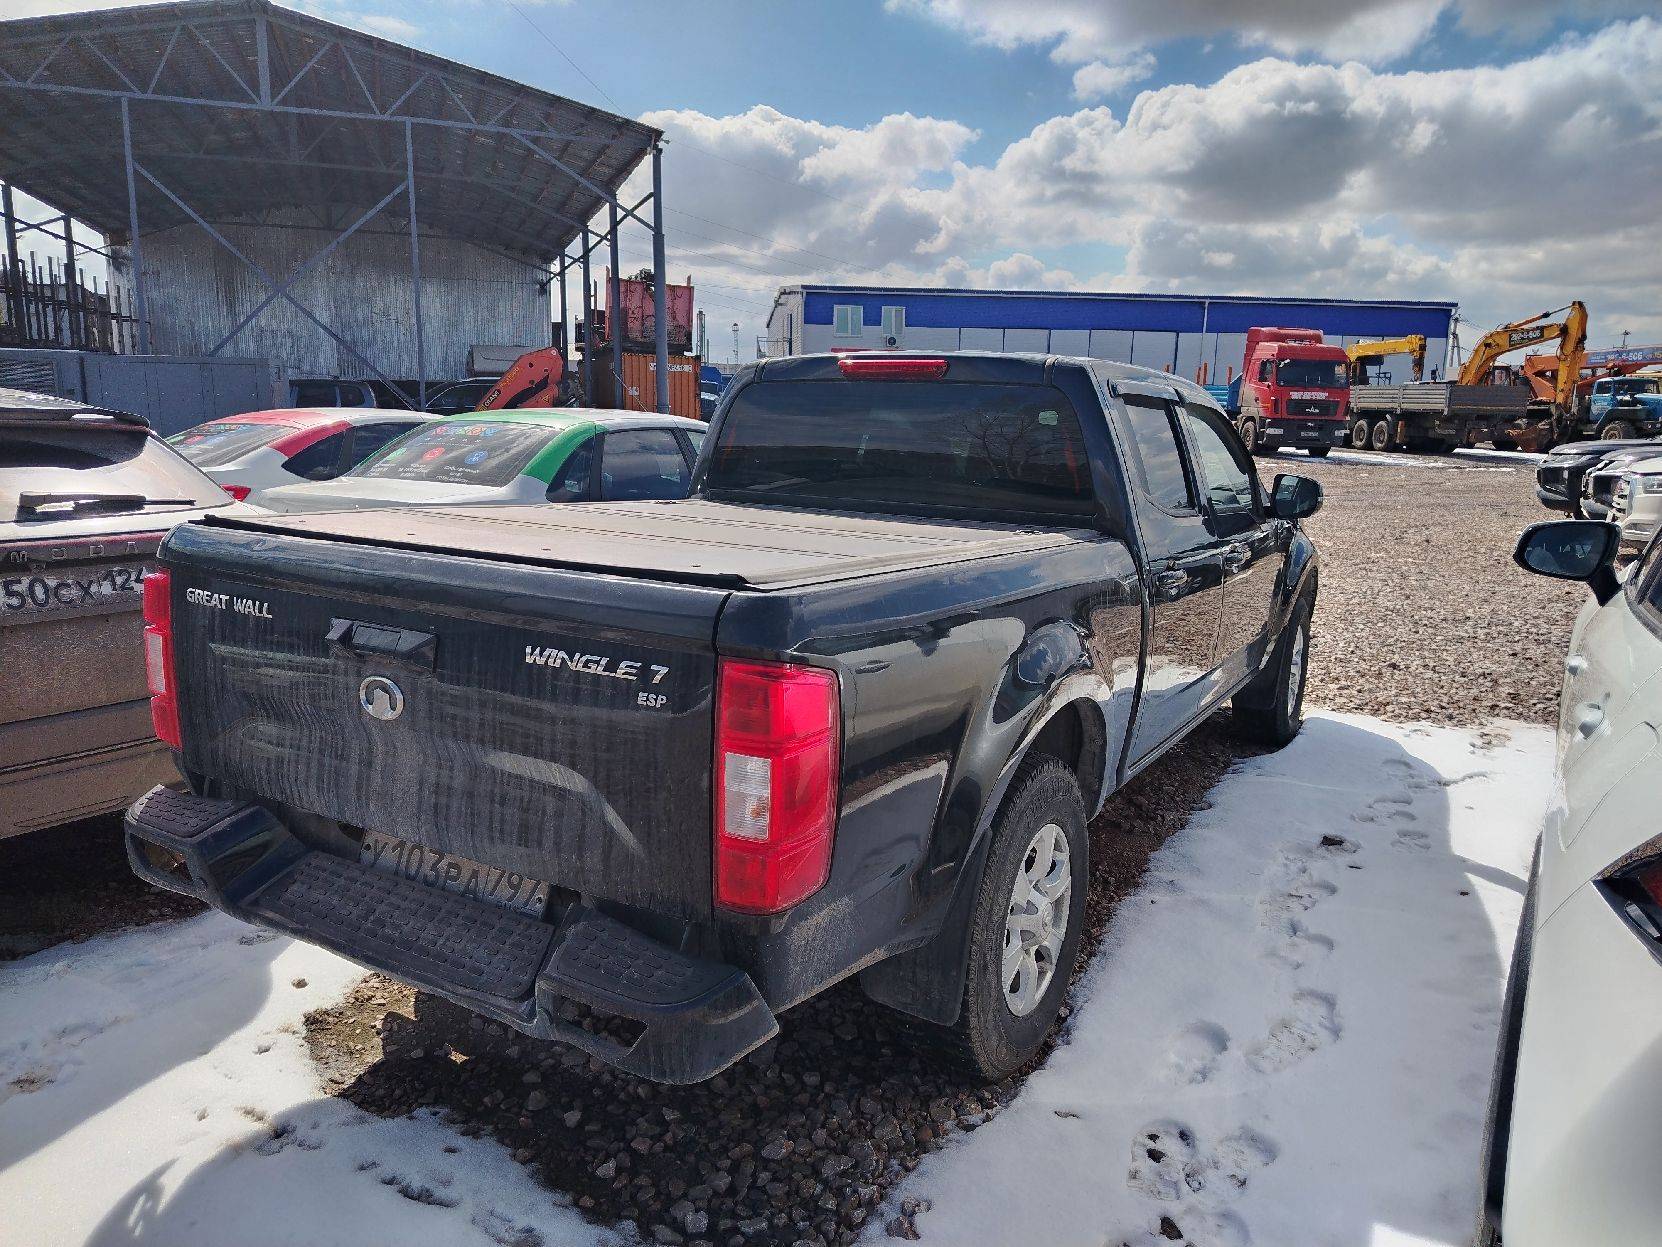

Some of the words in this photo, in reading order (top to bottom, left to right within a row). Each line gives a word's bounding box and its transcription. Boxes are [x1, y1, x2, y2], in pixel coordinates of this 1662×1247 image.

[186, 587, 230, 610] GREAT
[233, 594, 273, 619] WALL
[525, 645, 642, 681] WINGLE
[650, 664, 670, 685] 7
[637, 691, 668, 709] ESP
